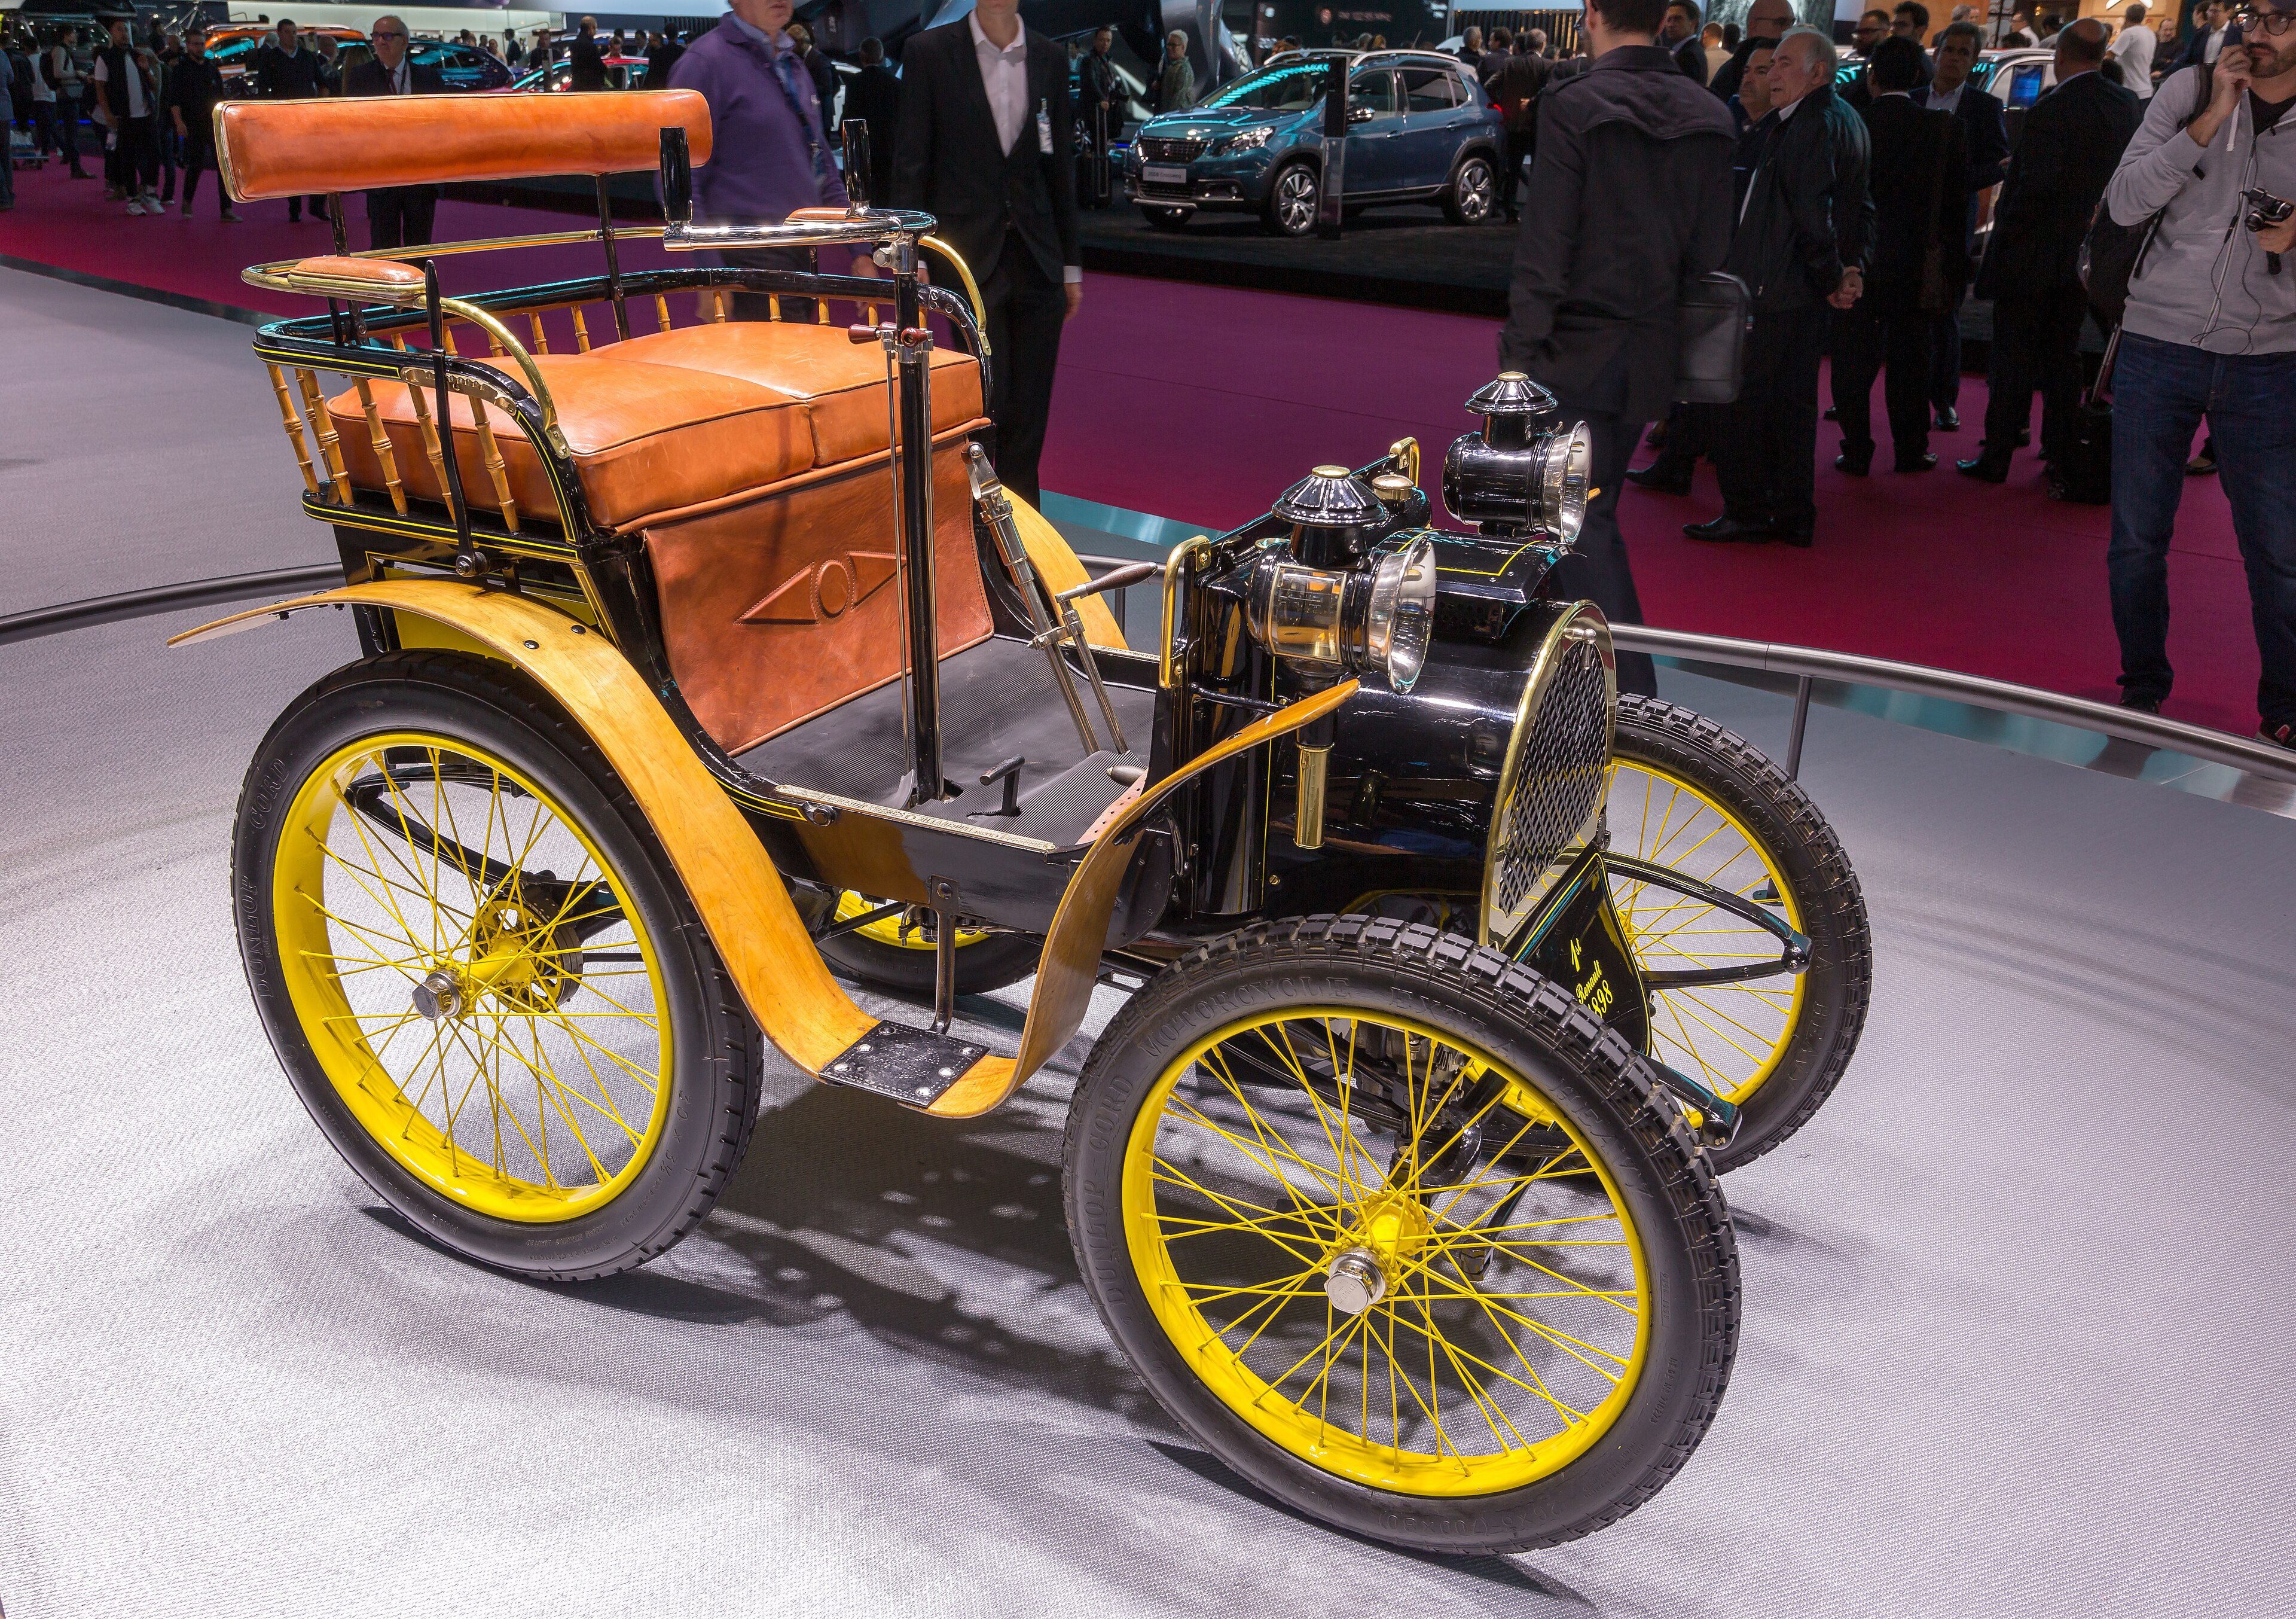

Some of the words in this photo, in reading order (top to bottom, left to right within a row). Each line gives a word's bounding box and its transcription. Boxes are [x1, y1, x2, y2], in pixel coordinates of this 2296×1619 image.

[249, 757, 289, 830] CORD
[1626, 734, 1793, 854] MOTORCYCLE
[240, 874, 274, 1001] DUNLOP
[1794, 874, 1833, 974] EXTRA
[1570, 938, 1581, 972] 1st
[1576, 959, 1602, 1004] Renault
[1588, 980, 1613, 1019] 898
[1137, 977, 1352, 1058] MOTORCYCLE
[1390, 987, 1518, 1058] EXTRA
[674, 1090, 692, 1122] 30
[1089, 1075, 1133, 1154] CORD
[1550, 1078, 1653, 1197] HEAVY
[367, 1165, 413, 1206] ENGLAND
[413, 1204, 426, 1216] IN
[429, 1214, 459, 1236] MADE
[1083, 1181, 1127, 1310] DUNLOP
[1211, 1429, 1269, 1475] ENGLAND
[1274, 1474, 1292, 1489] IN
[1296, 1485, 1338, 1511] MADE
